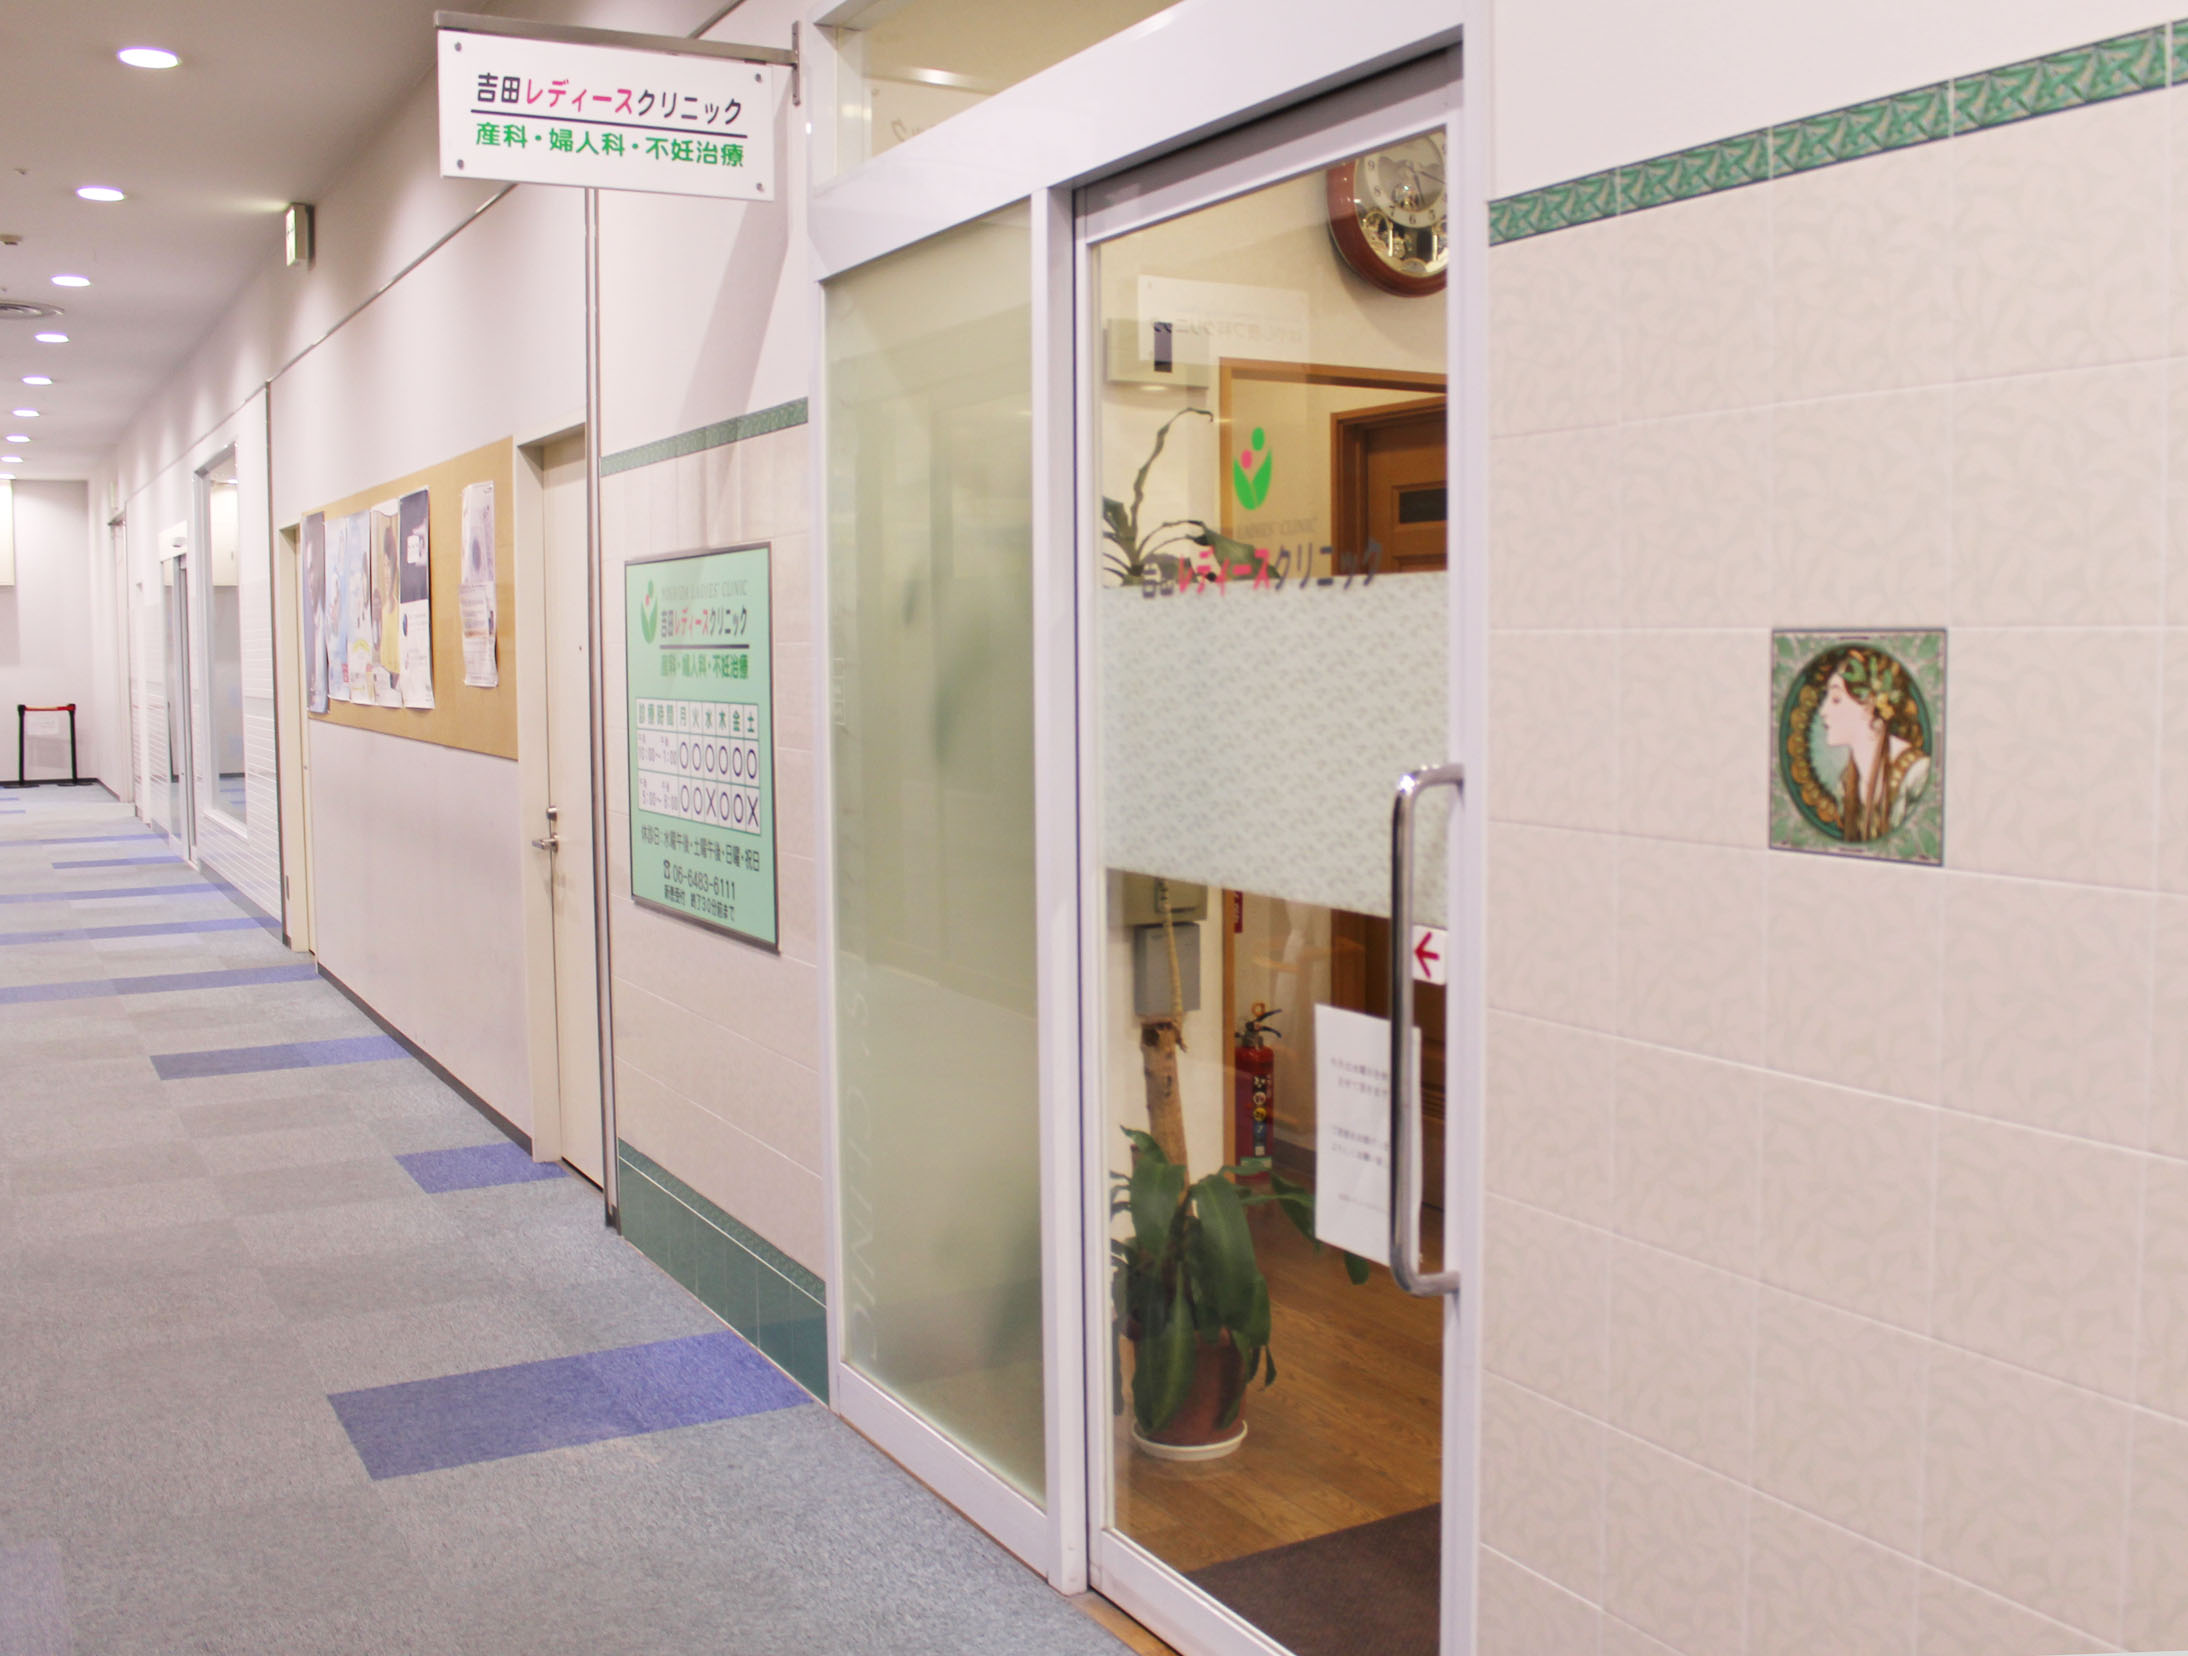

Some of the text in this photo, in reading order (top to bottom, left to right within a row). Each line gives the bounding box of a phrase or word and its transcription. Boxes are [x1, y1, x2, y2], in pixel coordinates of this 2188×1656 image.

[477, 72, 742, 126] 吉田レディースクリニック
[476, 122, 744, 167] 産科・婦人科・不妊治療
